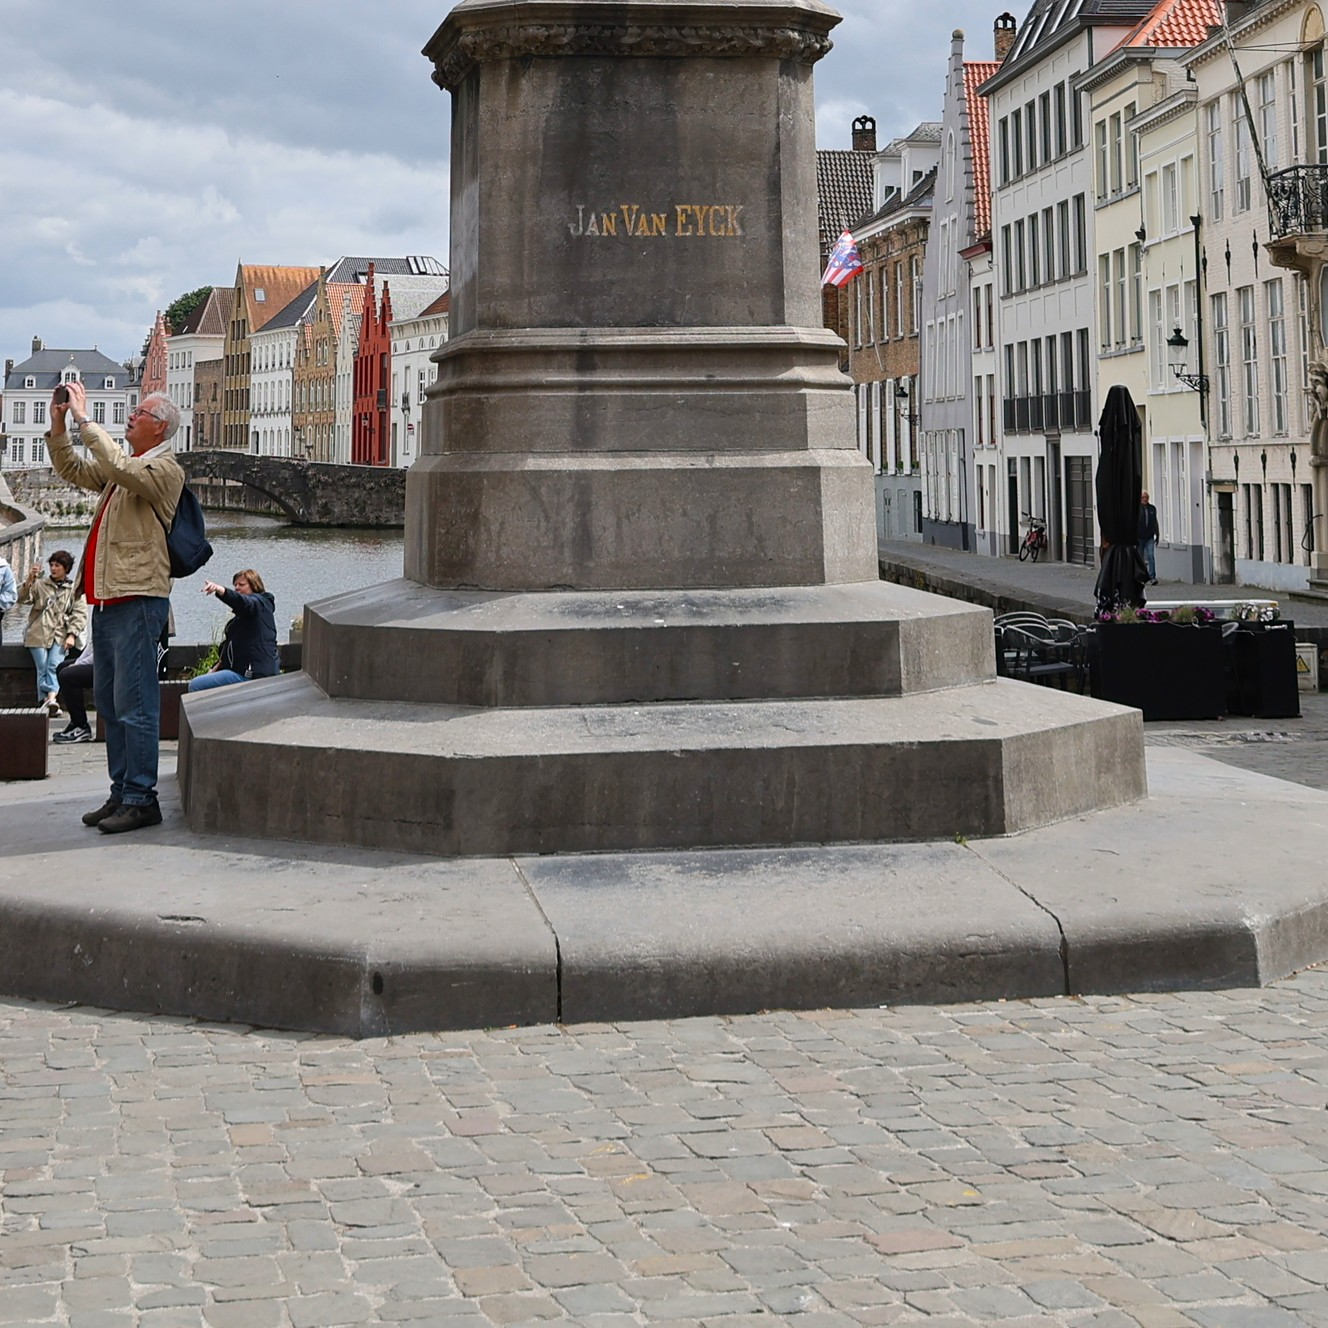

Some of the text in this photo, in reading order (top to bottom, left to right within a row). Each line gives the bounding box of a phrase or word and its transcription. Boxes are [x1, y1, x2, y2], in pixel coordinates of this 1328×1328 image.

[568, 204, 745, 237] JAN VAN EYCK
